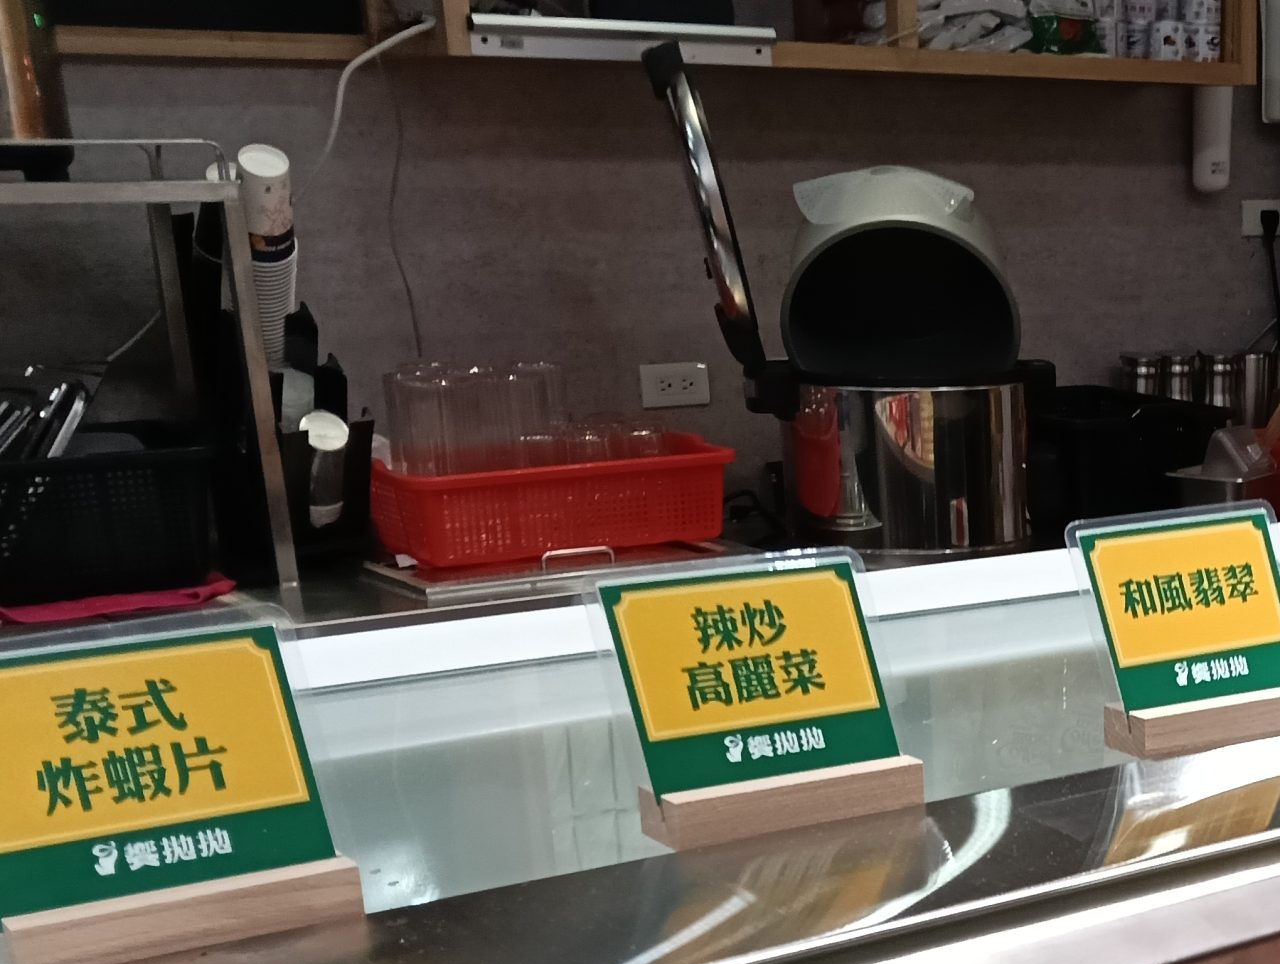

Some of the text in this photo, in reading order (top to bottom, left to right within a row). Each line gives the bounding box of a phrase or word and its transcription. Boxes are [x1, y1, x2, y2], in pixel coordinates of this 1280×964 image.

[1119, 562, 1258, 619] 和風翡翠
[690, 599, 787, 654] 辣炒
[50, 678, 188, 744] 泰式
[681, 648, 826, 711] 高麗菜
[37, 736, 228, 816] 炸蝦片
